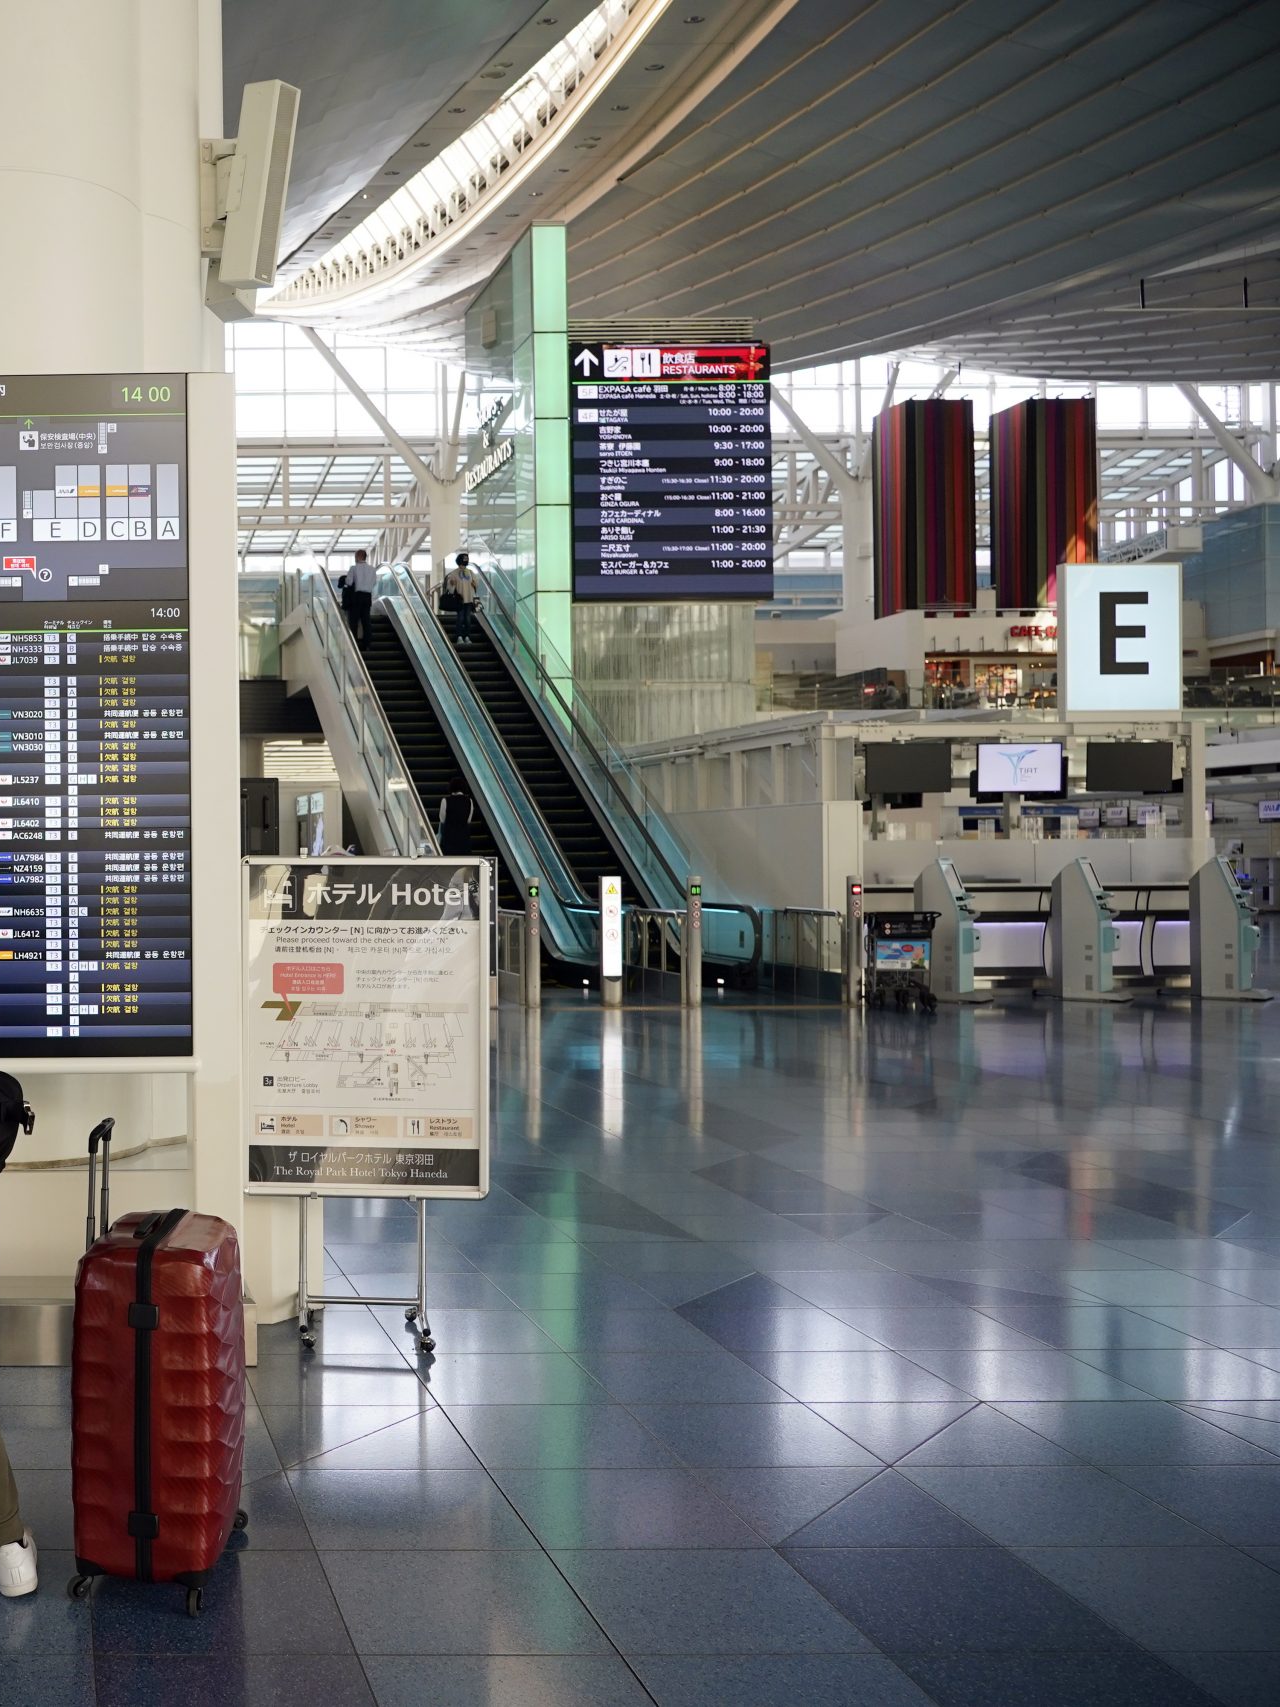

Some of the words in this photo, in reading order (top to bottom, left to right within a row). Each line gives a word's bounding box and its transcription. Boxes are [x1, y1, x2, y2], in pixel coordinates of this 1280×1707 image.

[663, 352, 696, 364] 飲食店
[663, 365, 735, 374] RESTAURANTS
[122, 387, 142, 402] 14
[149, 387, 170, 401] 00
[719, 384, 735, 392] 8:00
[743, 384, 764, 392] 17:00
[709, 408, 731, 416] 10:00
[741, 441, 764, 449] 17:00
[711, 475, 732, 483] 11:30
[741, 475, 765, 483] 20:00
[710, 492, 734, 500] 11:00
[2, 523, 11, 538] F
[51, 522, 61, 537] E
[84, 522, 96, 537] D
[111, 521, 124, 537] C
[135, 521, 146, 536] B
[162, 521, 175, 536] A
[742, 525, 766, 533] 21:30
[712, 560, 733, 568] 11:00
[151, 608, 180, 617] 14:00
[1100, 592, 1149, 675] E
[308, 883, 381, 905] ホテル
[392, 883, 469, 906] Hotel
[288, 1153, 297, 1163] ザ
[396, 1154, 433, 1166] 東京羽田
[274, 1166, 293, 1175] The
[296, 1167, 322, 1177] Royal
[326, 1167, 347, 1176] Park
[350, 1167, 376, 1177] Hotel
[380, 1169, 407, 1179] Tokyo
[410, 1169, 448, 1178] Haneda
